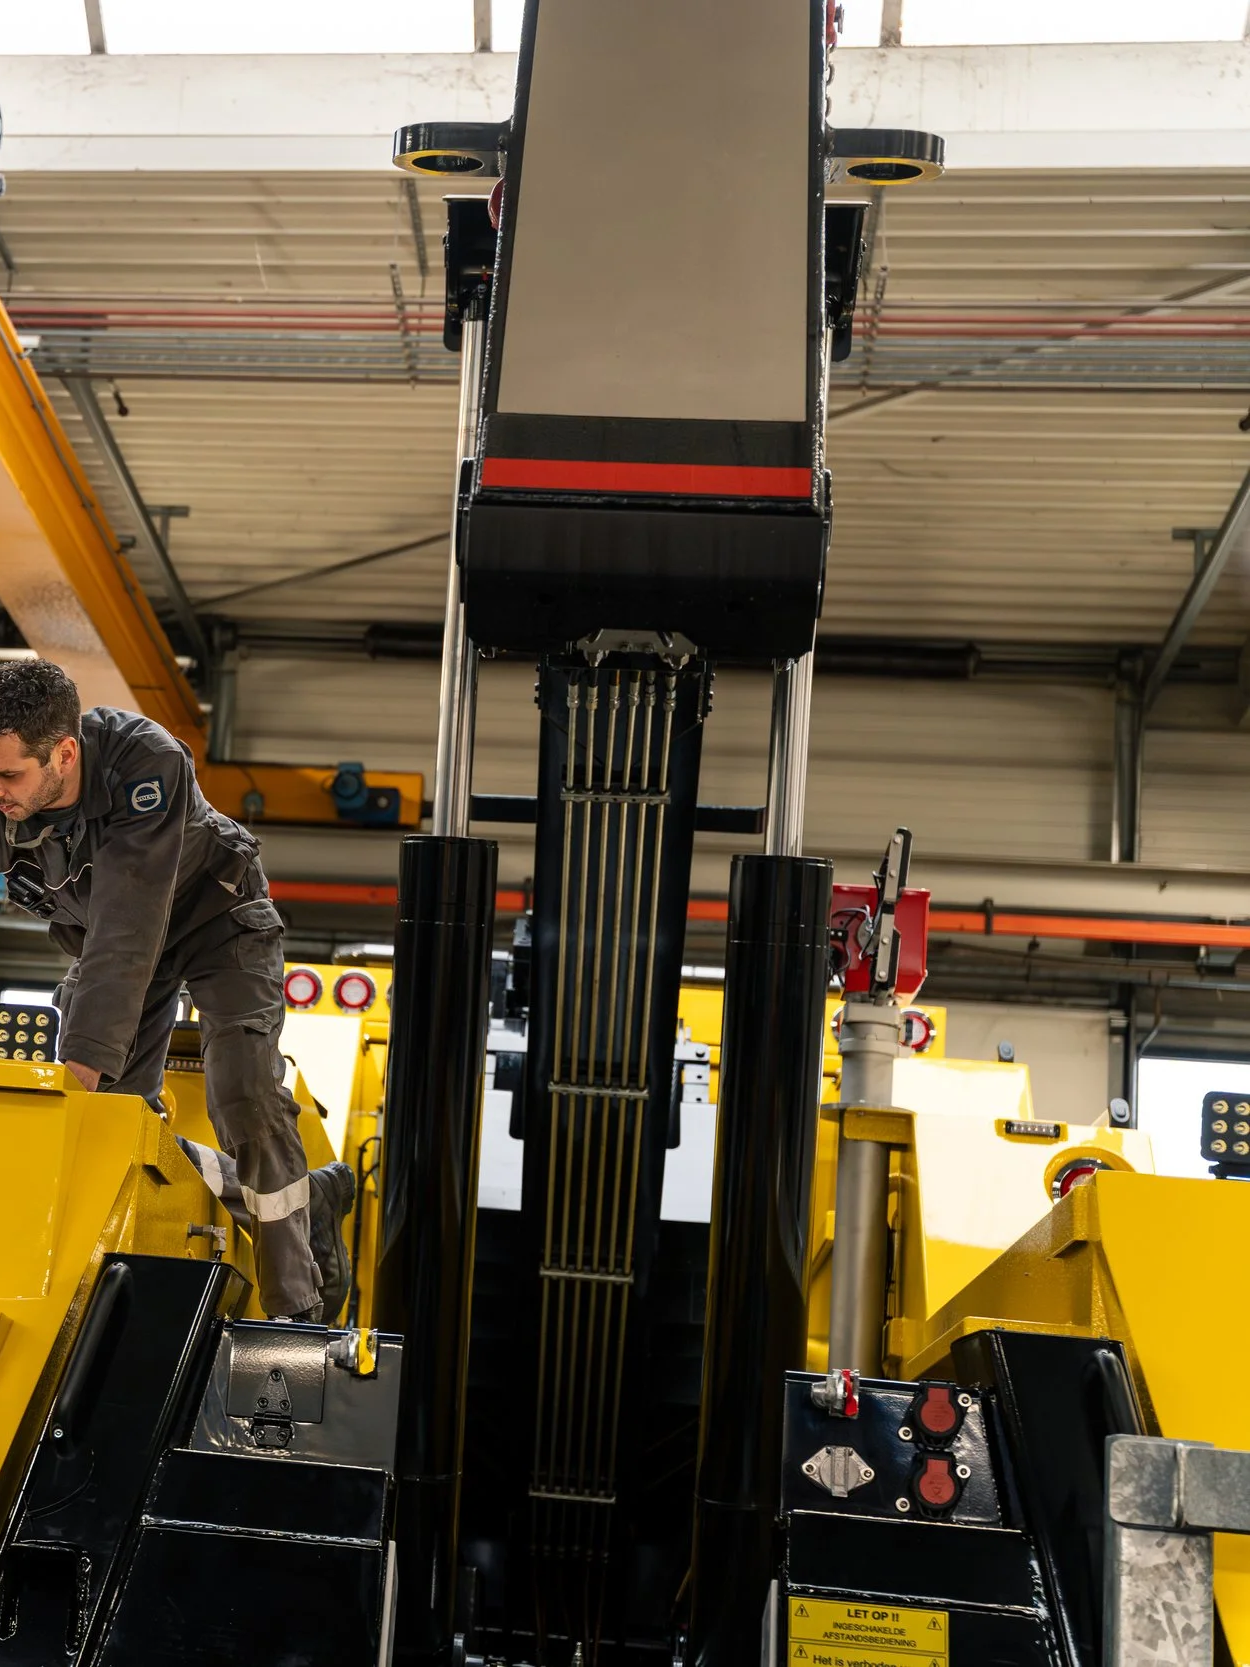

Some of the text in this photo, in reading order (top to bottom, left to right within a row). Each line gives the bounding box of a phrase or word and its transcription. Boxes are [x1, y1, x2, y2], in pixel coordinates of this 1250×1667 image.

[847, 1608, 868, 1619] LET
[871, 1611, 888, 1621] OP
[833, 1621, 906, 1636] INGESCHAKELDE
[823, 1632, 917, 1648] AFSTANDSBEDIENING
[813, 1654, 897, 1667] Het is verbod
